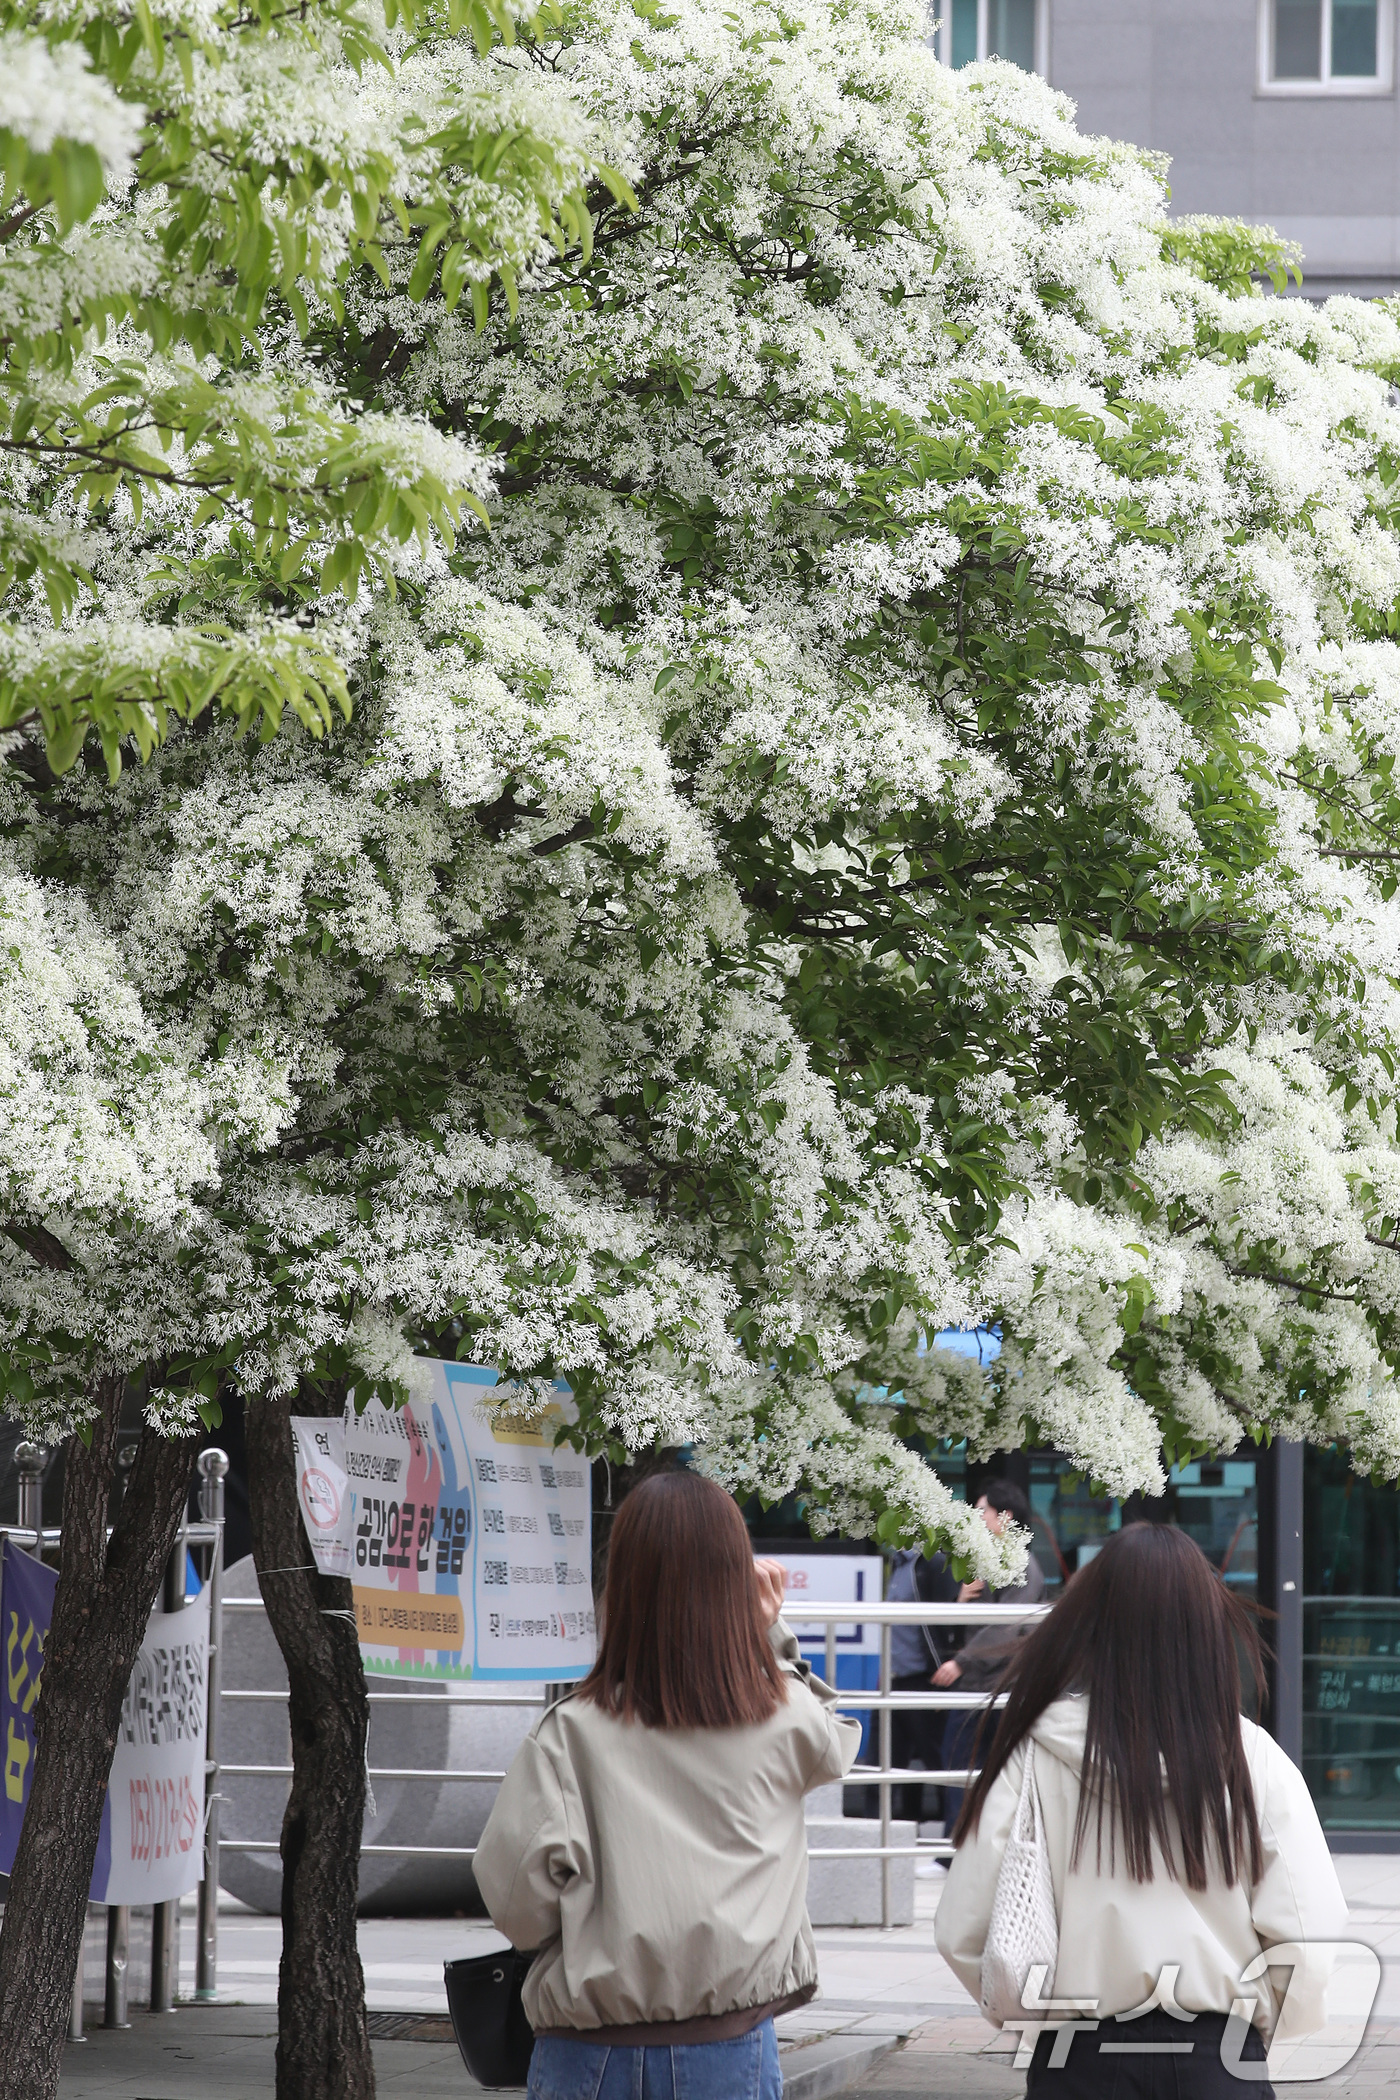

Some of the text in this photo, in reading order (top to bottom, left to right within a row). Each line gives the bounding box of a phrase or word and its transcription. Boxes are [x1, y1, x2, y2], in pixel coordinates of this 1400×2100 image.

[314, 1431, 331, 1456] 연
[356, 1496, 471, 1575] 공감으로 한 걸음
